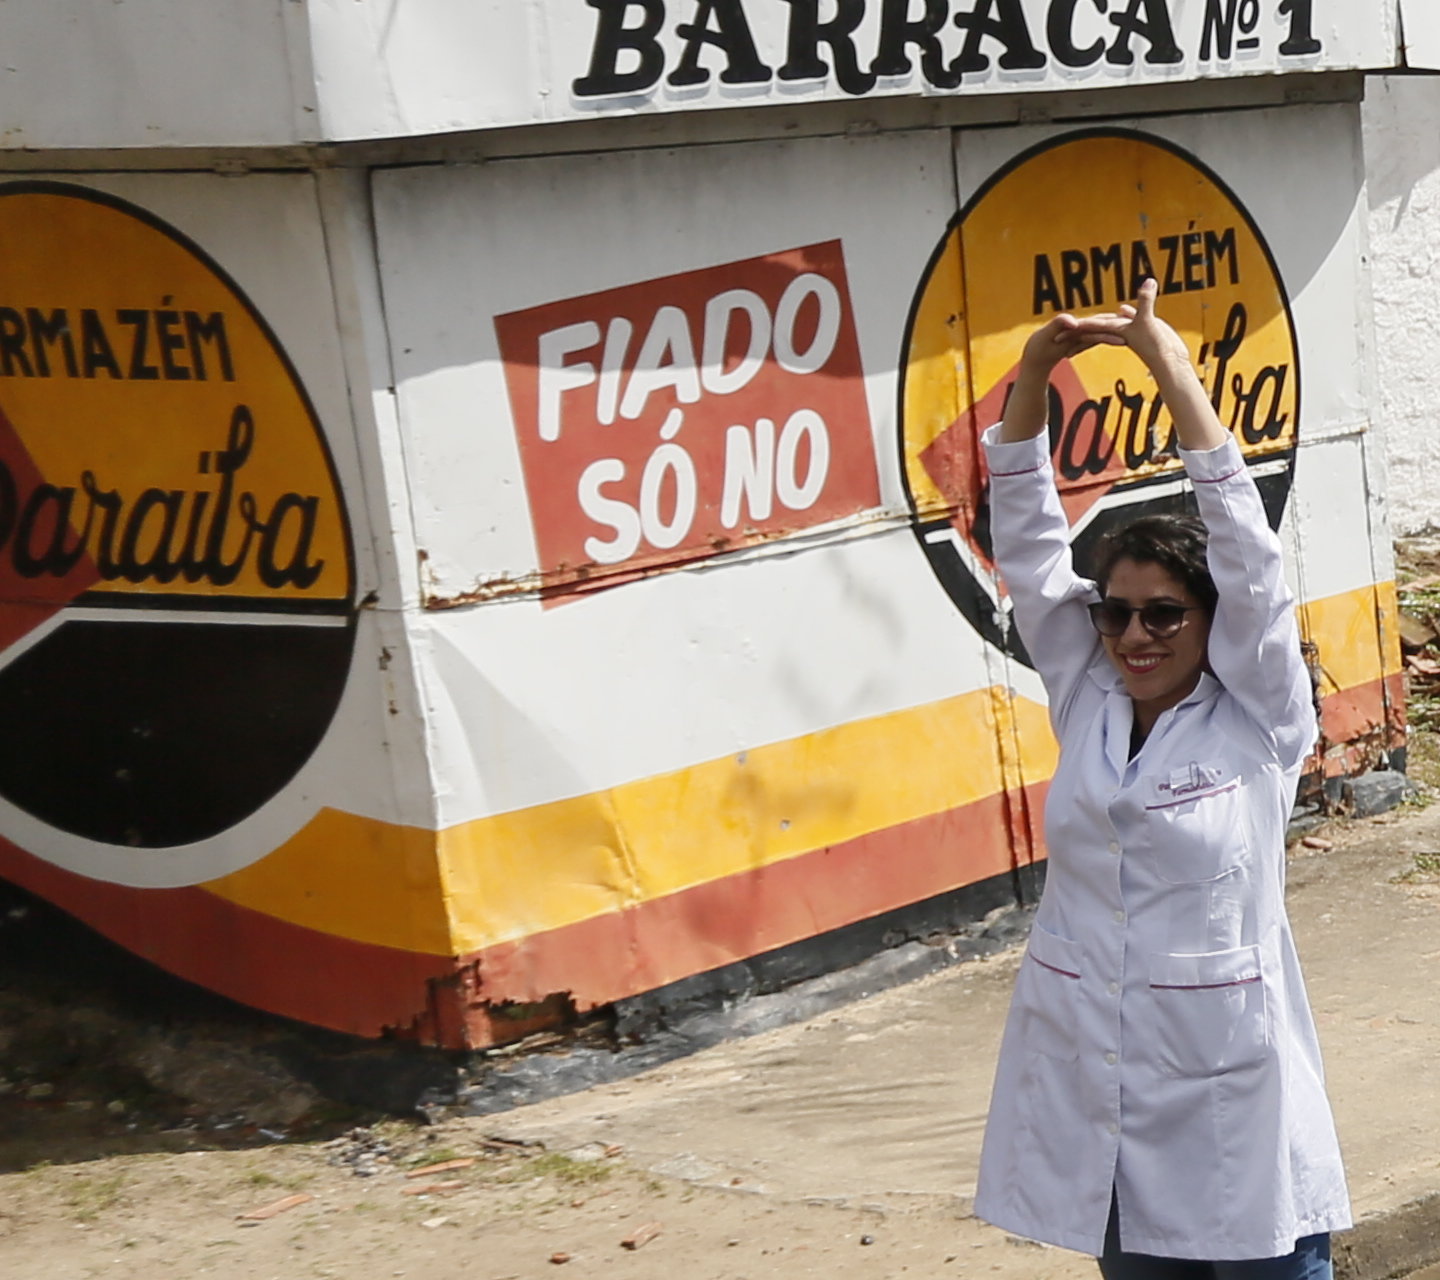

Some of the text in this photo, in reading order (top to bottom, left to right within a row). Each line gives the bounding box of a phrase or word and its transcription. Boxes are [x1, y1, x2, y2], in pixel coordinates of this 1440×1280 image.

[1033, 221, 1239, 315] ARMAZÉM
[0, 295, 236, 382] RMAZÉM
[538, 272, 841, 442] FIADO
[578, 408, 830, 565] SÓ NO
